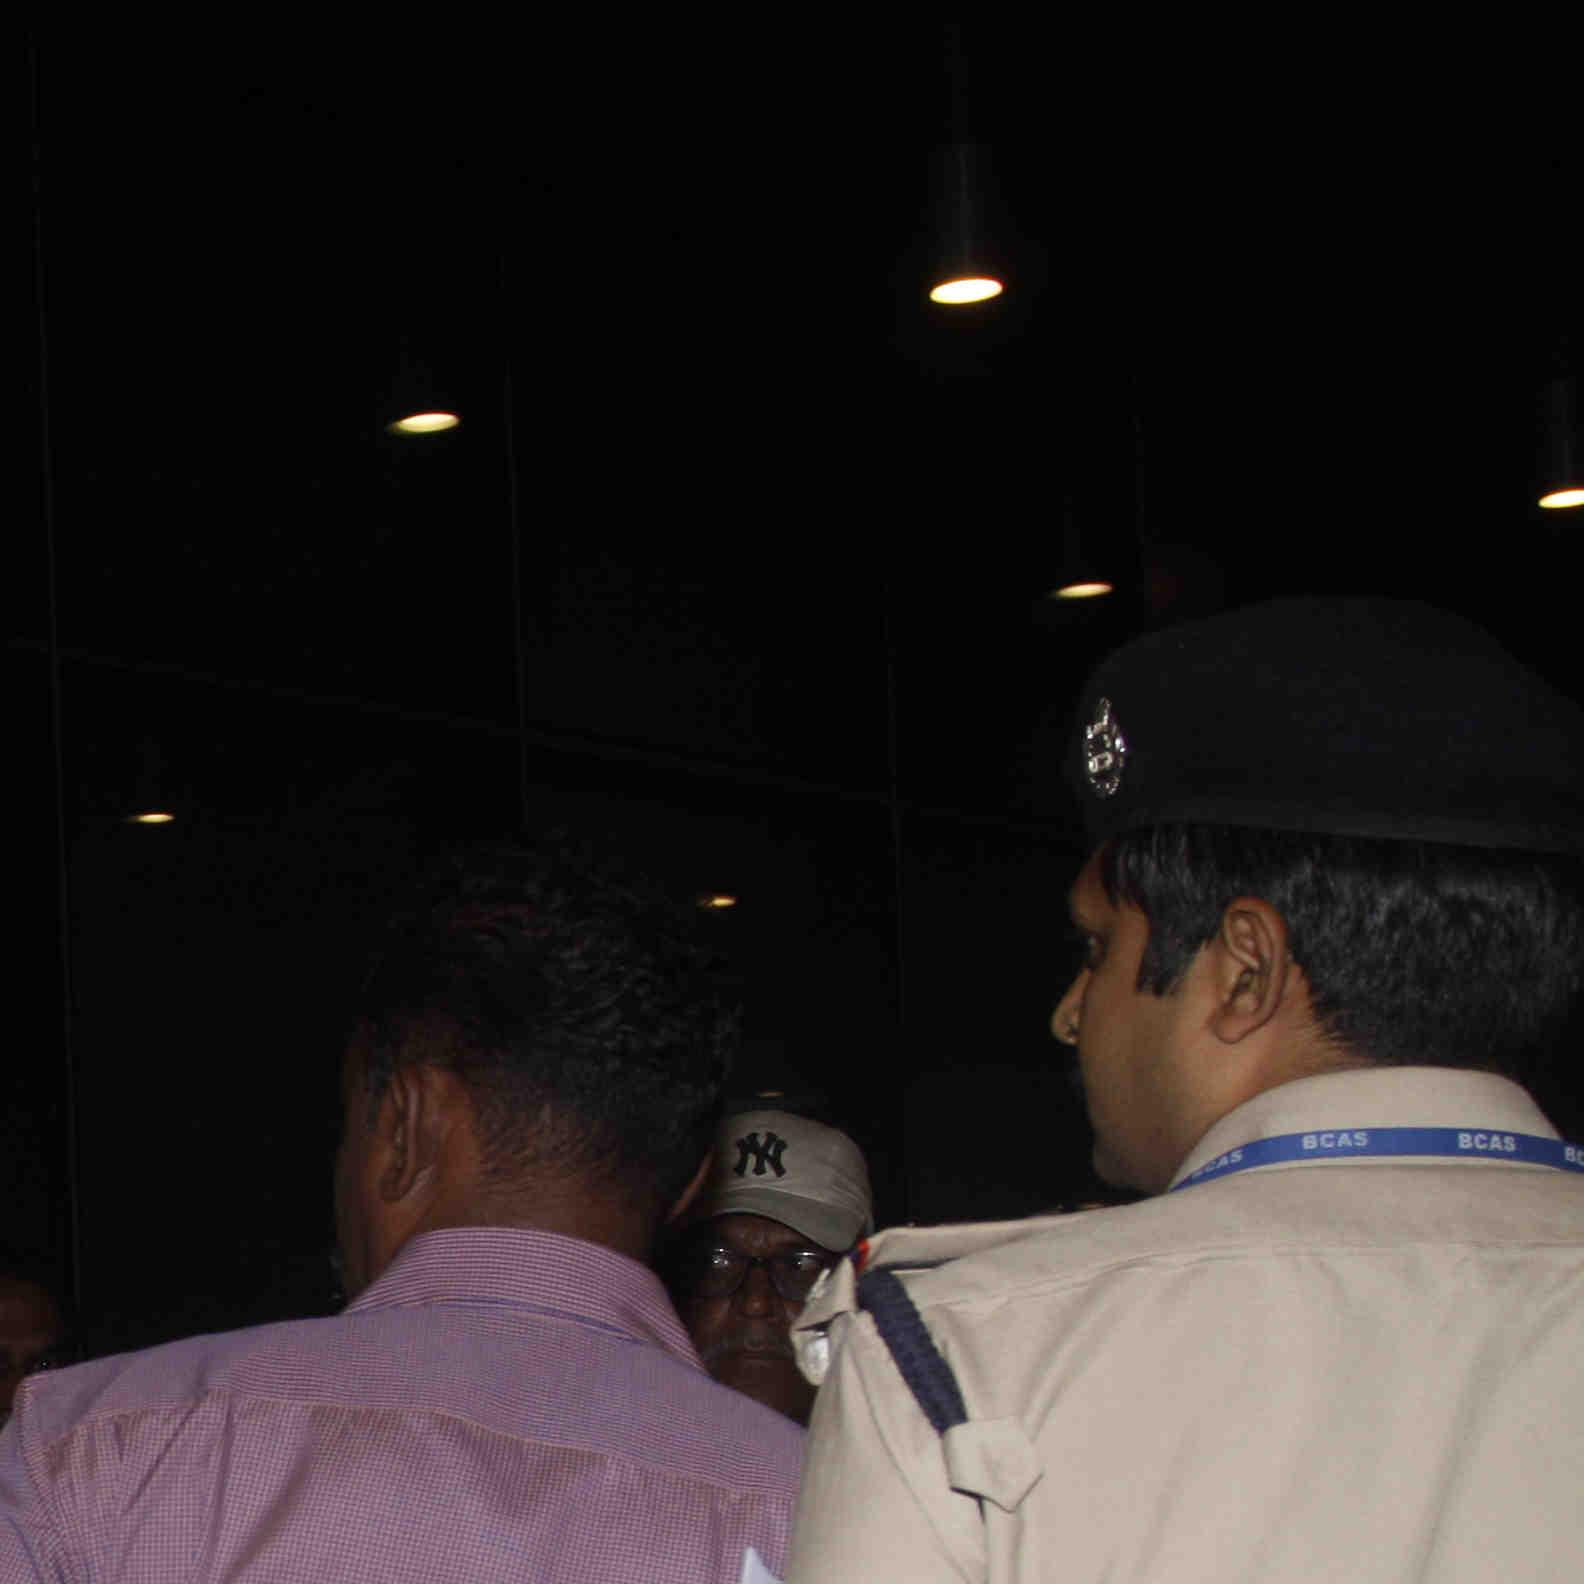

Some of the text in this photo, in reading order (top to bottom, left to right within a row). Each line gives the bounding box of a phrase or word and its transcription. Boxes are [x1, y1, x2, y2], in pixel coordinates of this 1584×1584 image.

[734, 1132, 786, 1177] NY
[1302, 1131, 1369, 1150] BCAS
[1457, 1132, 1517, 1152] BCAS
